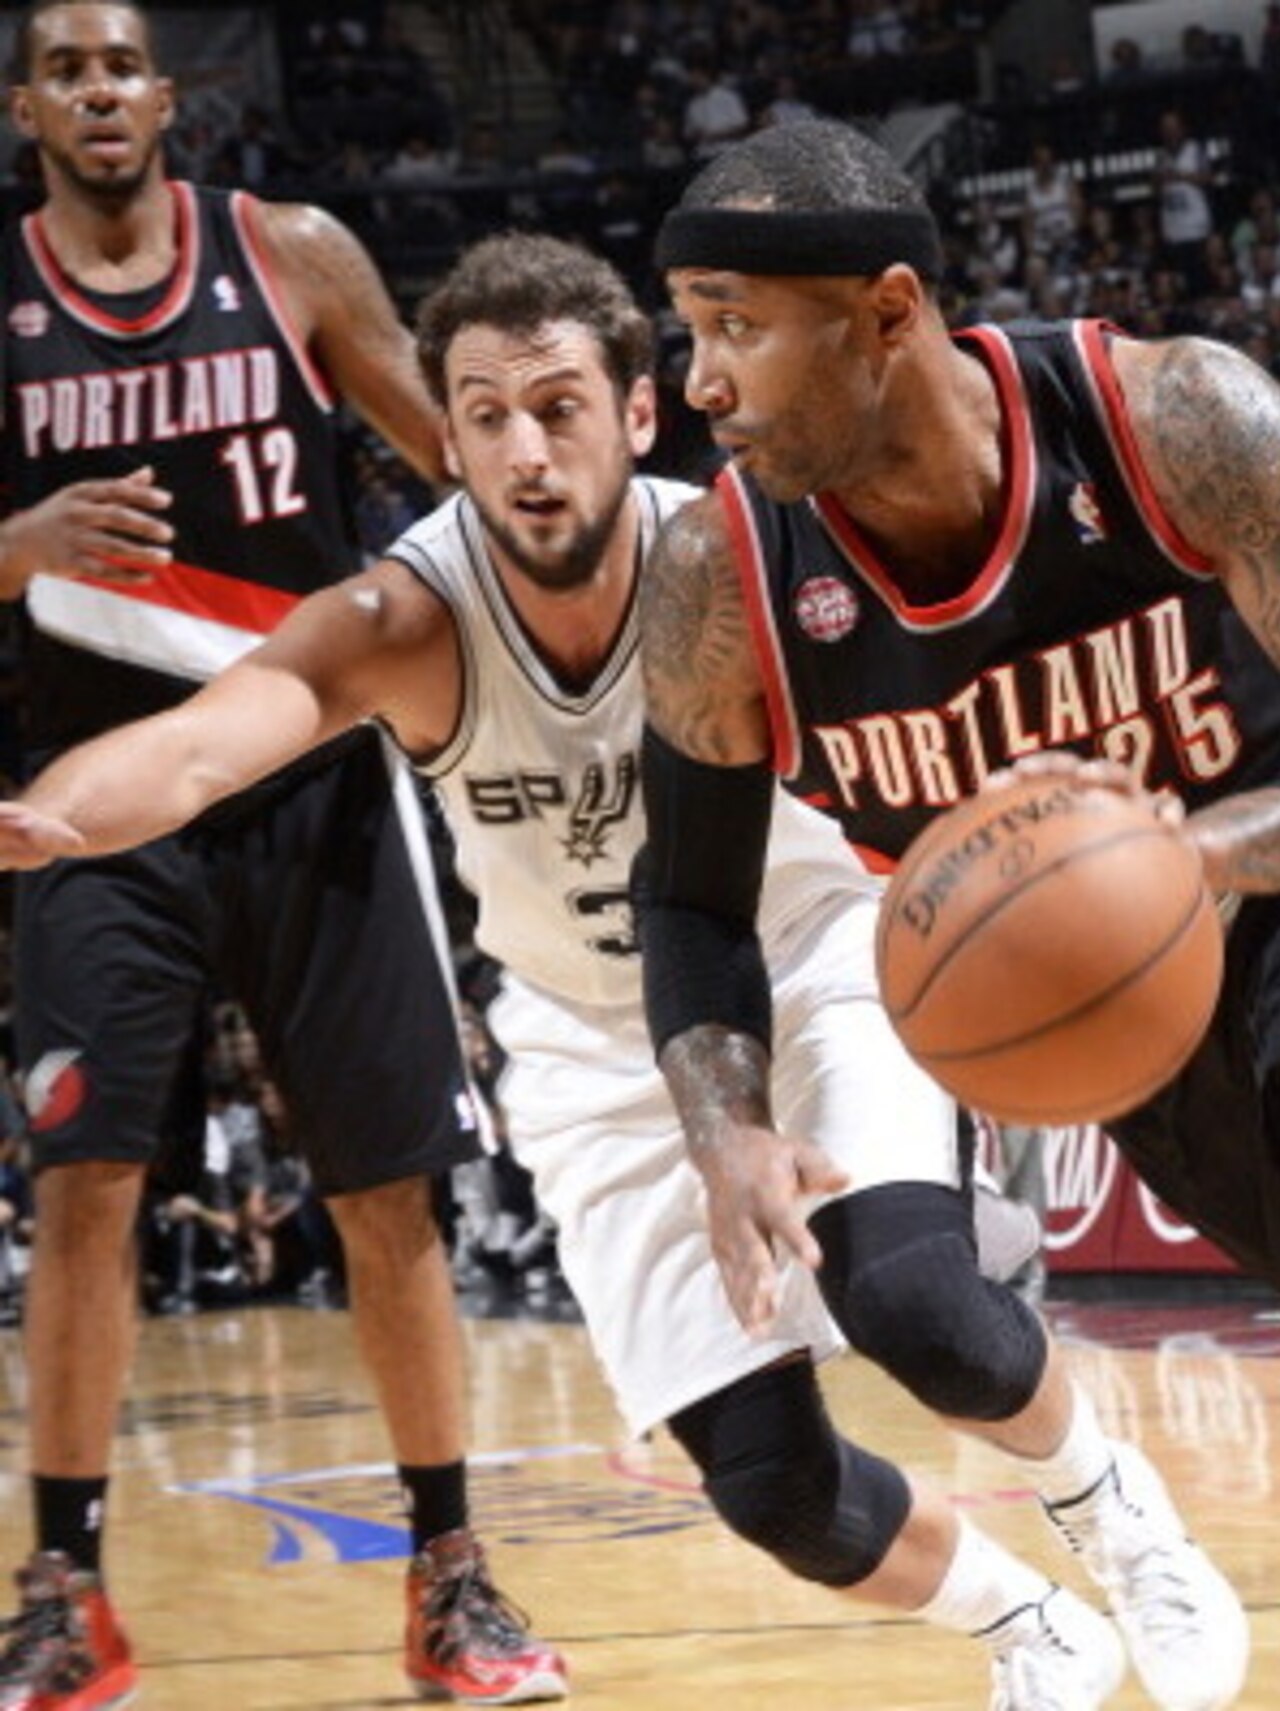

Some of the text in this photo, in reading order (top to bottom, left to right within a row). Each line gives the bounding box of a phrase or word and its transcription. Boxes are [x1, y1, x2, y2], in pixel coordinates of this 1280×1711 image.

[16, 346, 280, 460] PORTLAND
[219, 426, 308, 526] 12
[812, 597, 1190, 810] PORTLAND
